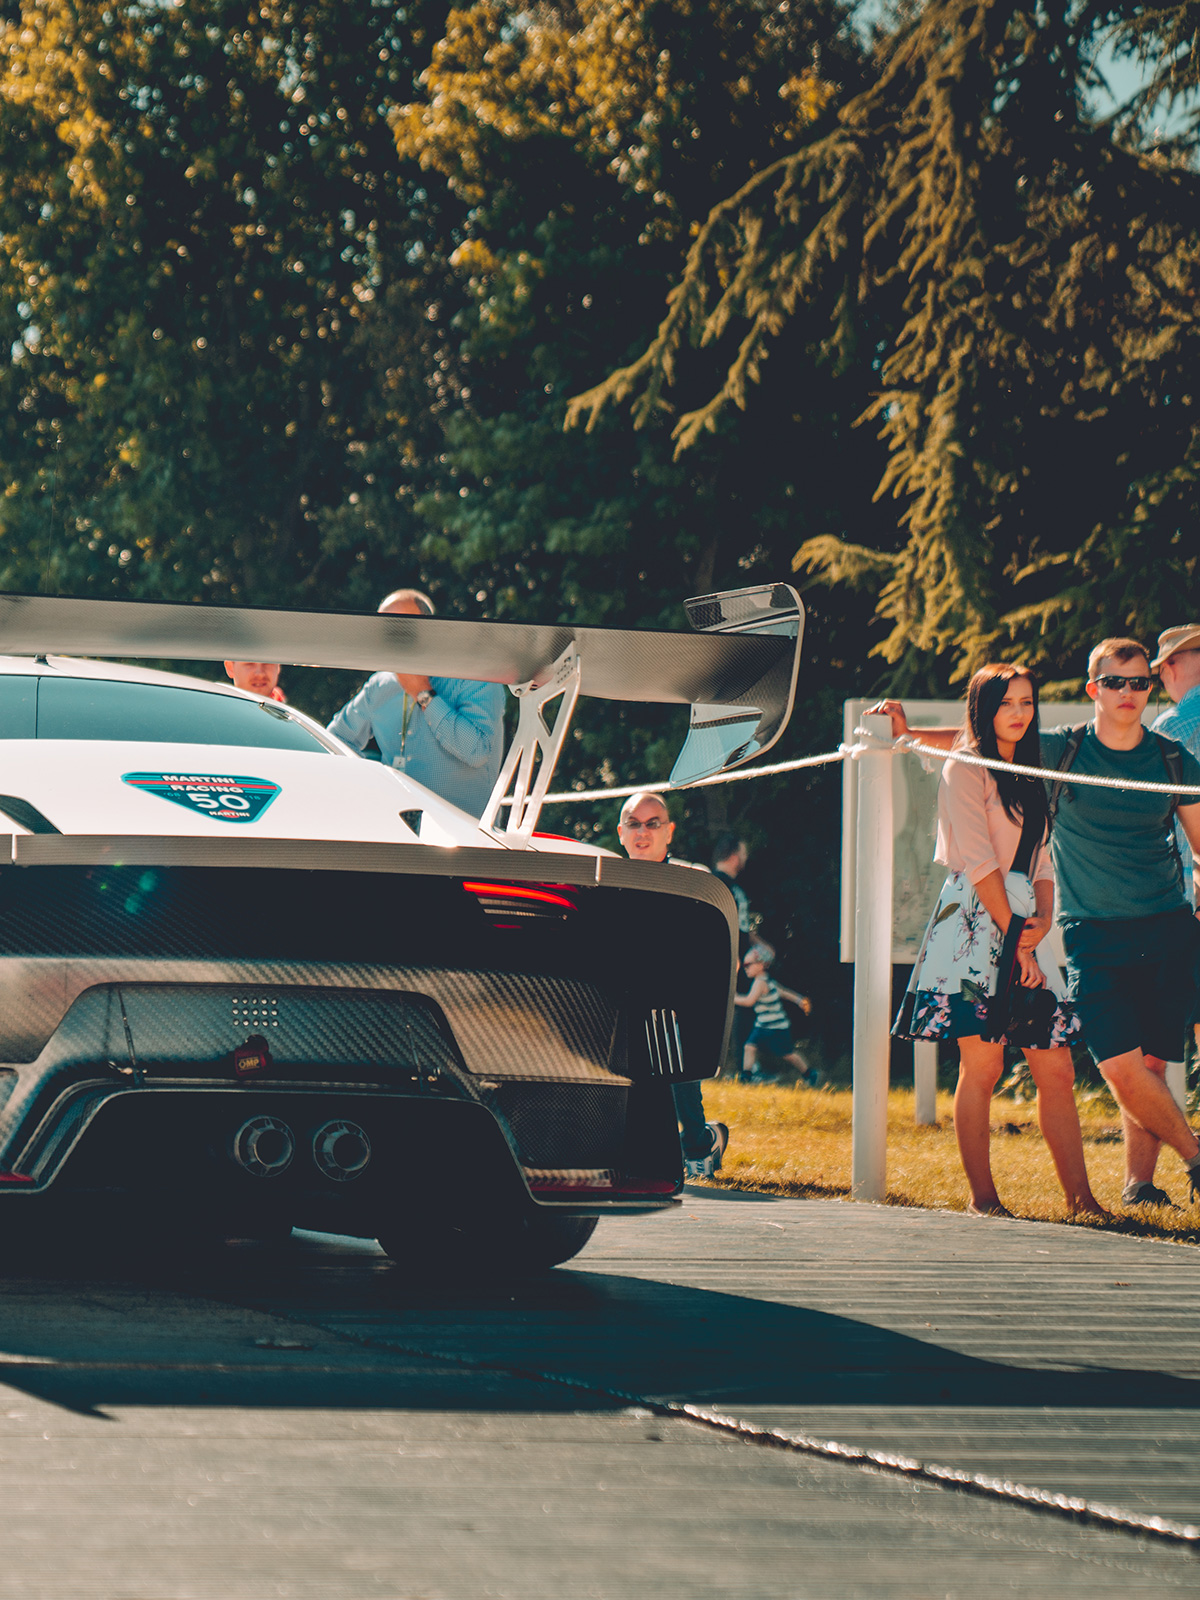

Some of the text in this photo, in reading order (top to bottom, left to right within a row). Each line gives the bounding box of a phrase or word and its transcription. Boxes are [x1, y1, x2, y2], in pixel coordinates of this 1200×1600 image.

[162, 775, 235, 784] MARTINI
[170, 785, 244, 793] RACING
[187, 793, 251, 811] 50
[238, 1056, 260, 1070] OMP
